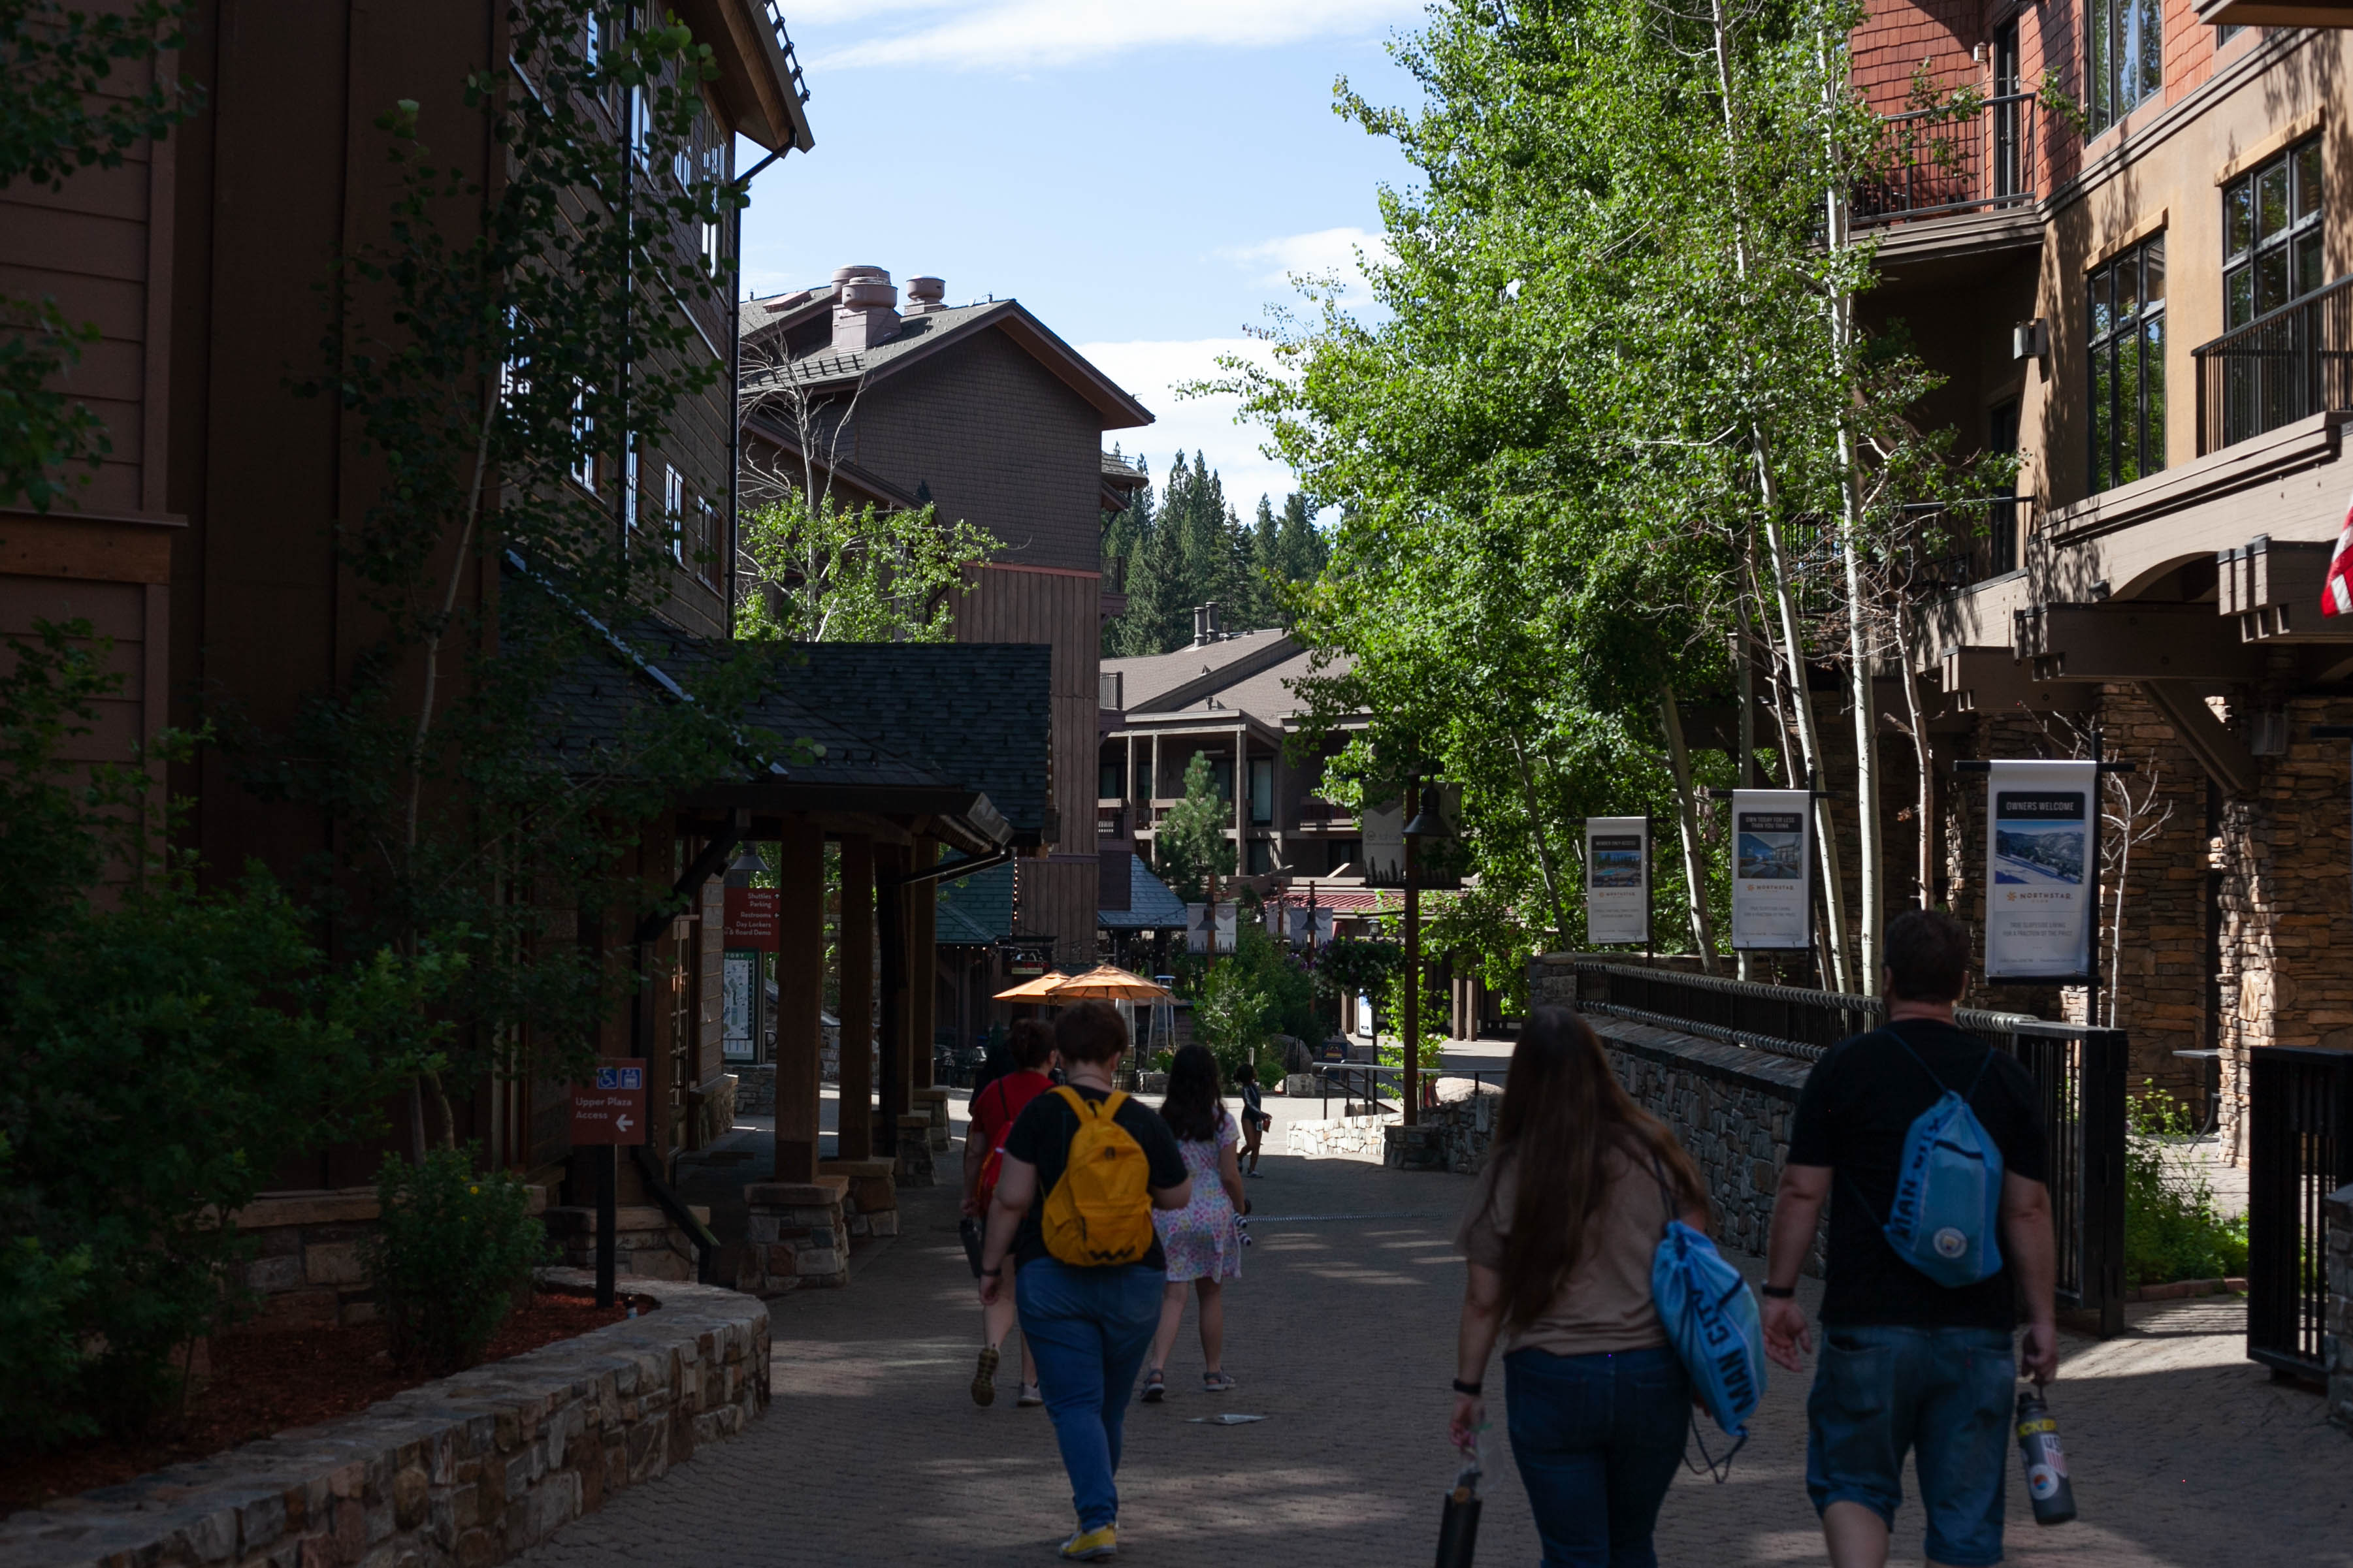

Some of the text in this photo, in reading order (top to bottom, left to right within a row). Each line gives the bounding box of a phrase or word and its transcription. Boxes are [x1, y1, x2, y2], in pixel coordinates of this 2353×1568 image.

[2006, 801, 2075, 810] OWNERS WELCOME
[750, 901, 772, 909] Parking
[736, 921, 748, 929] Day
[575, 1096, 633, 1108] Upper Plaza
[1717, 1348, 1755, 1415] MAN
